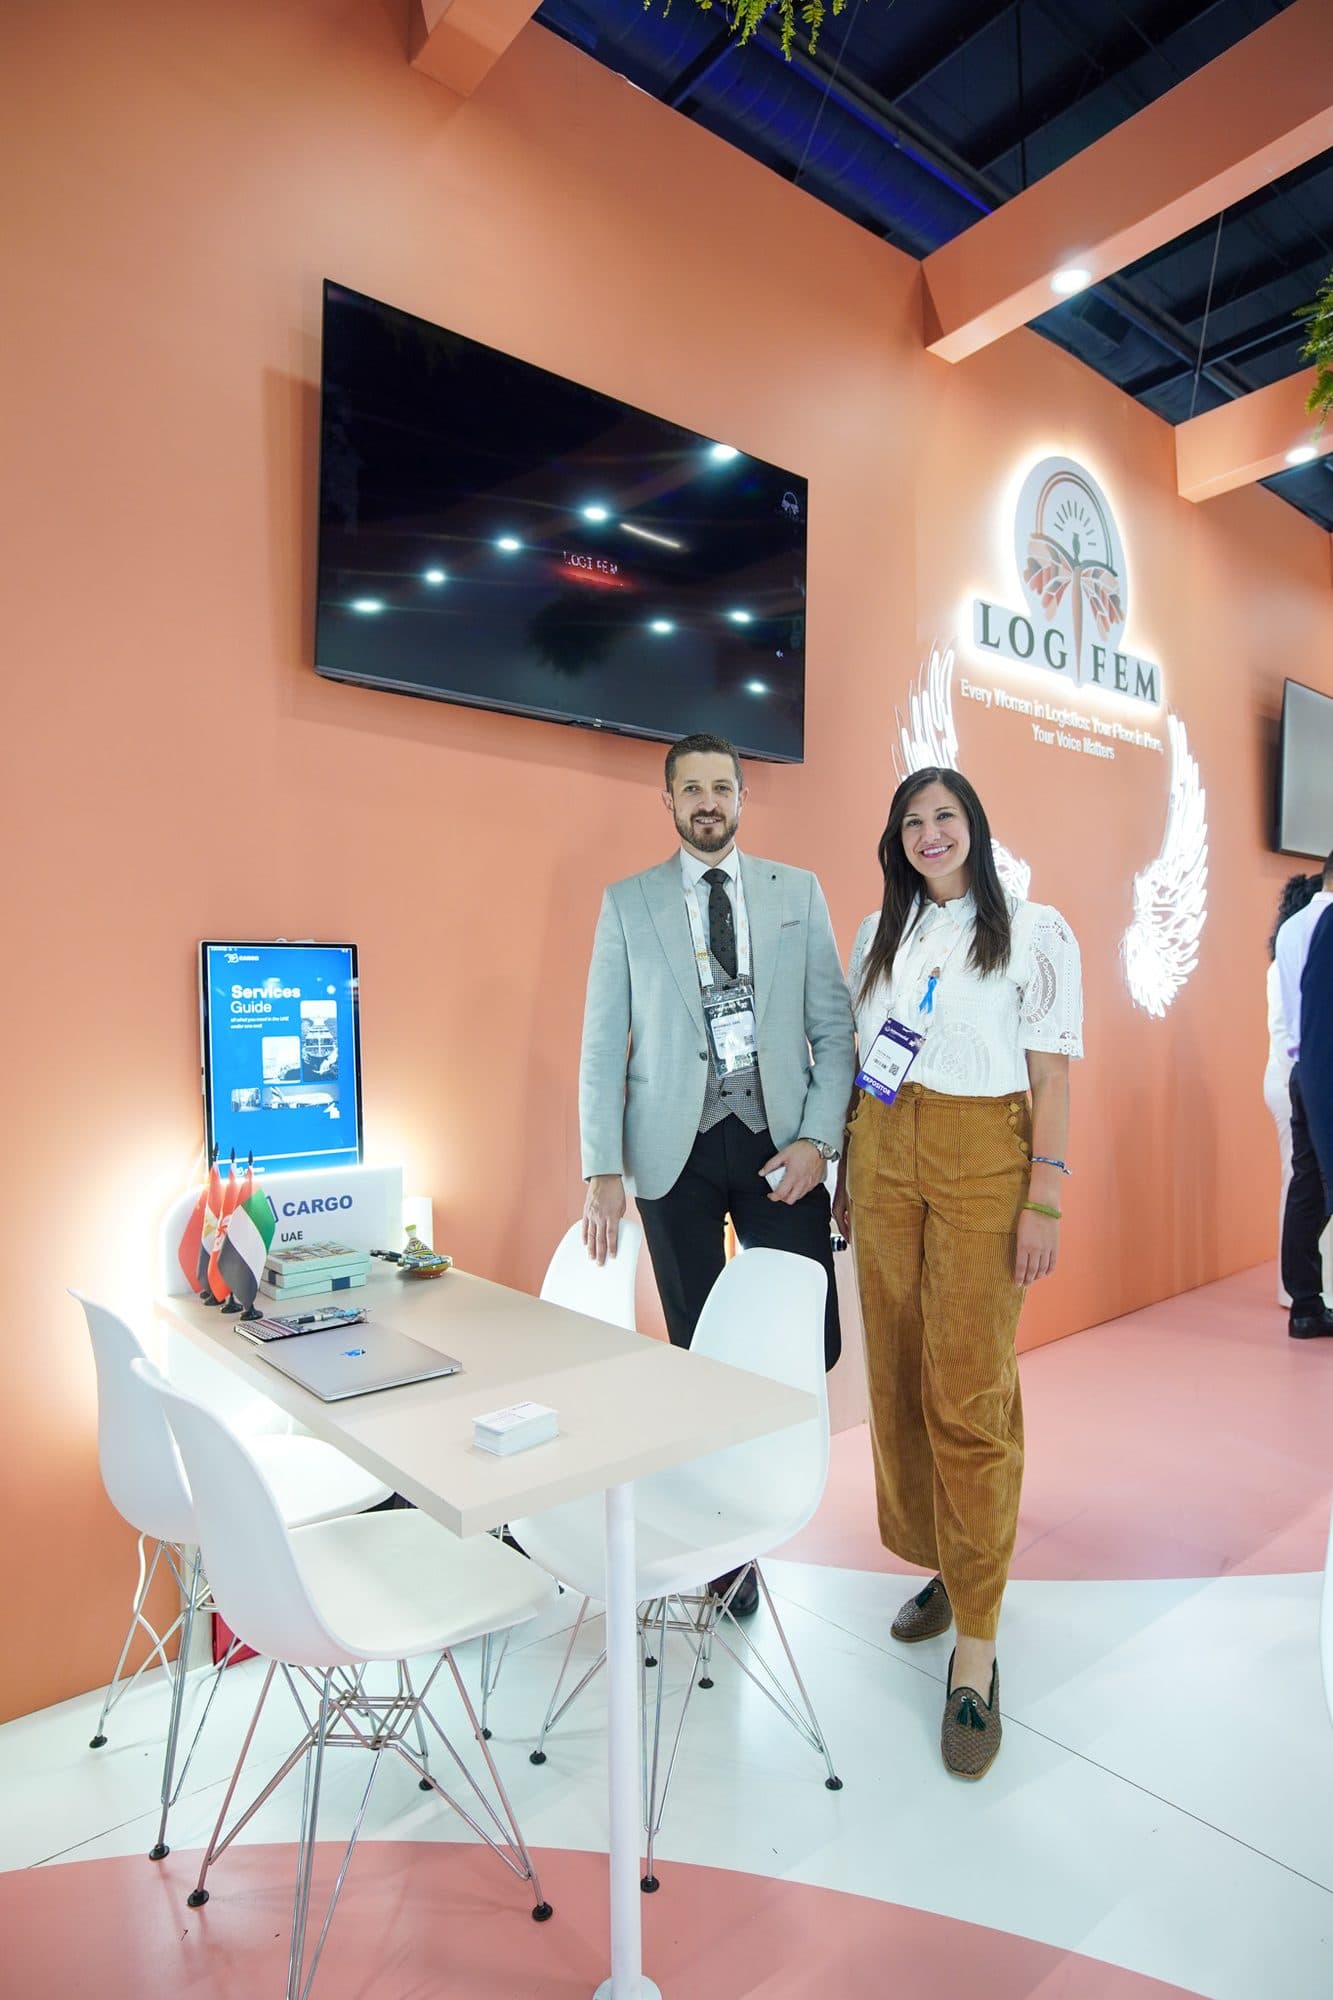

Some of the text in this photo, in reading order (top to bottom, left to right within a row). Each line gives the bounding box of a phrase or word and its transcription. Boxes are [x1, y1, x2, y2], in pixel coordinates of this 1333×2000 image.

[1091, 644, 1158, 703] FEM
[960, 679, 992, 708] Every
[1033, 700, 1045, 719] in
[1091, 715, 1113, 737] Your
[1032, 723, 1115, 760] Your Voice Matters
[231, 984, 301, 999] Services
[230, 1000, 272, 1014] Guide
[862, 1075, 892, 1097] EXPOSITOR
[282, 1195, 353, 1217] CARGO
[281, 1231, 304, 1242] UAE
